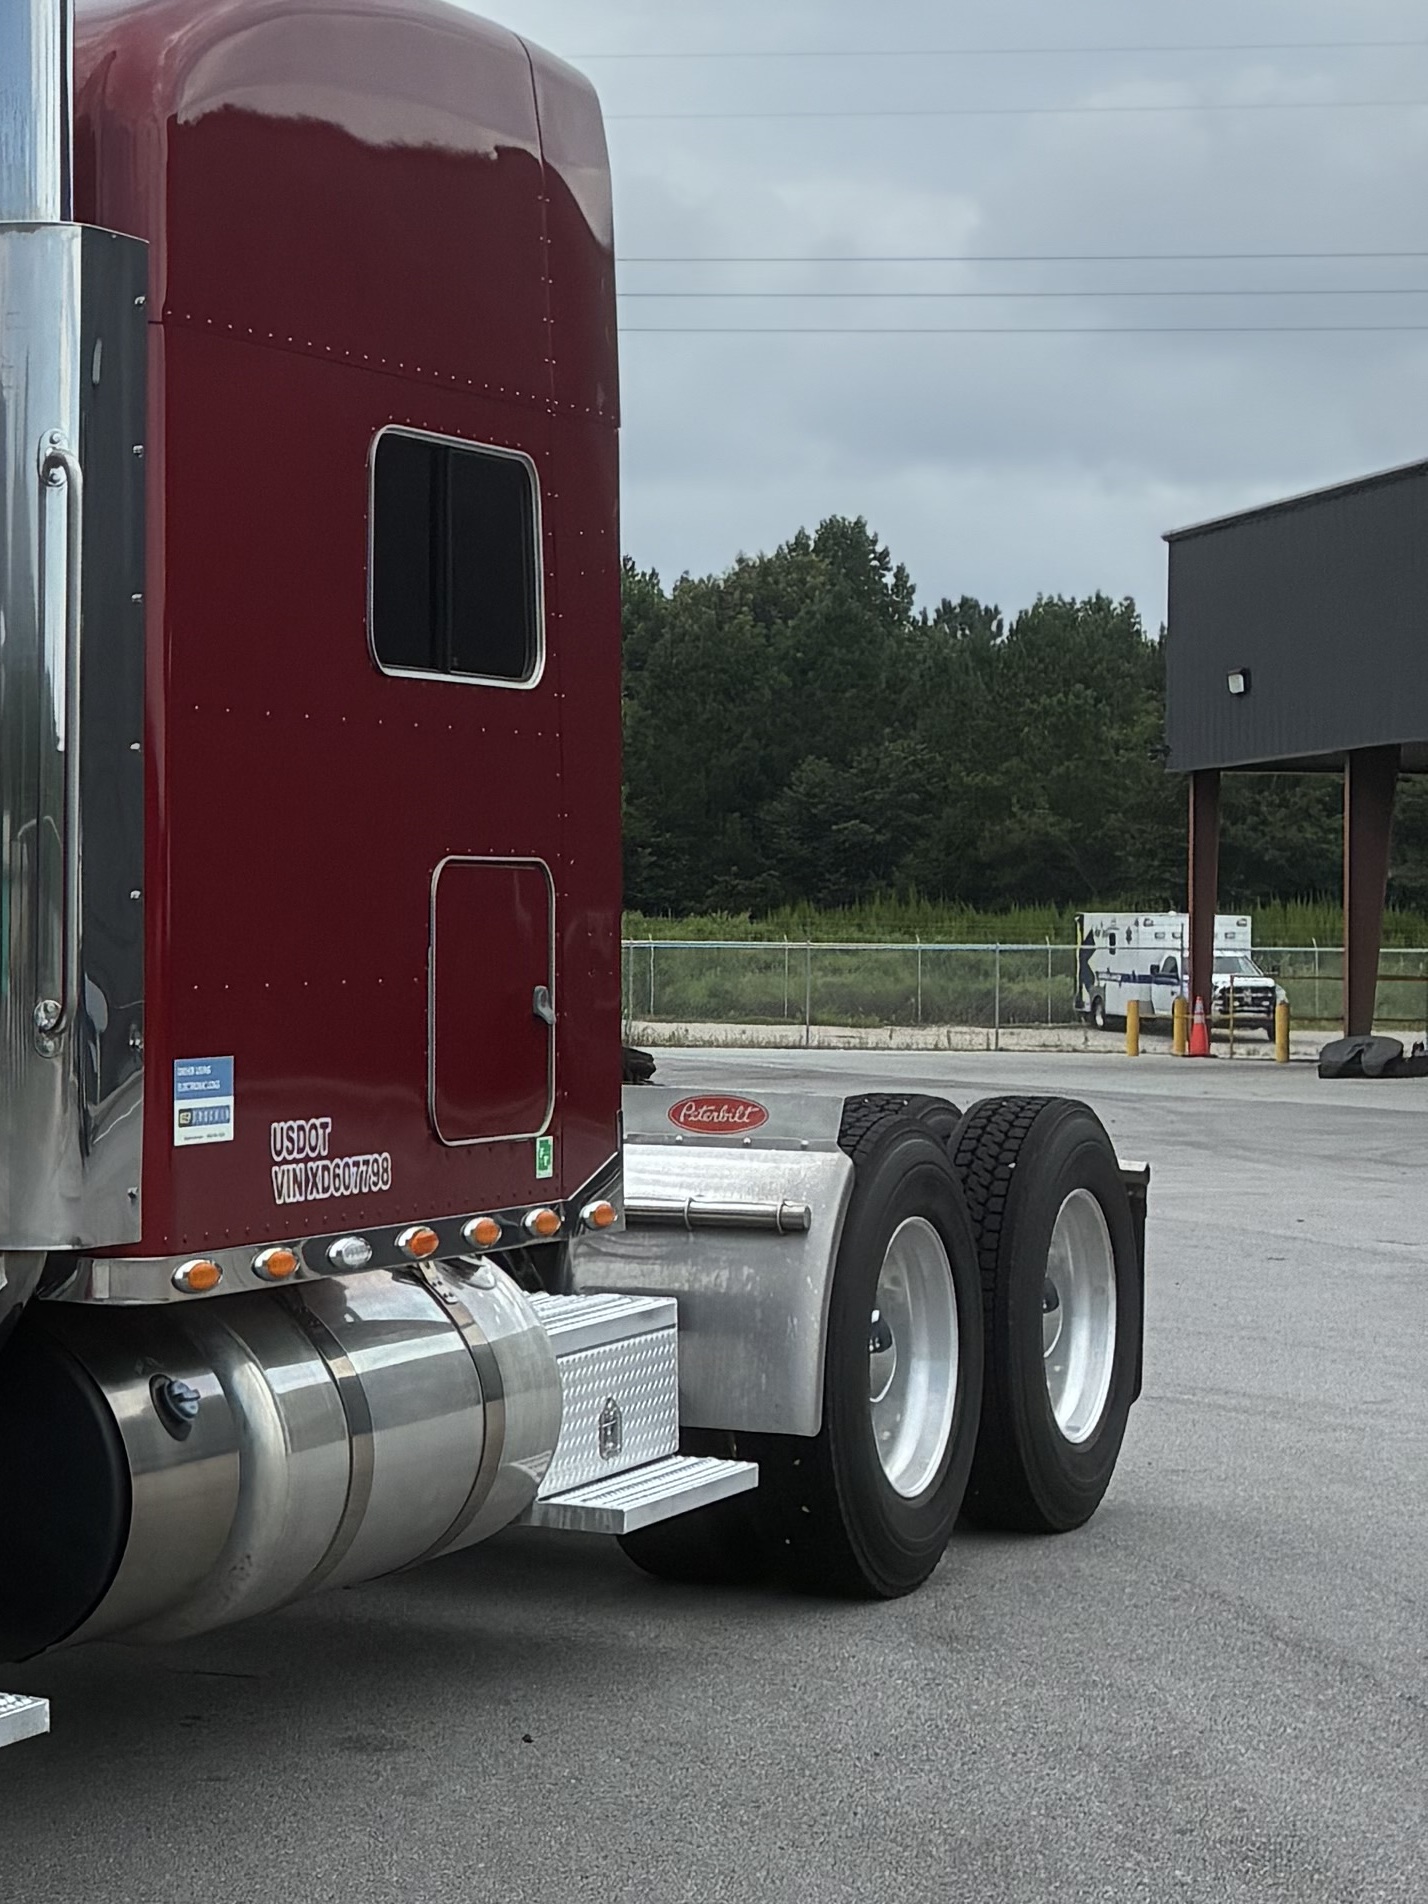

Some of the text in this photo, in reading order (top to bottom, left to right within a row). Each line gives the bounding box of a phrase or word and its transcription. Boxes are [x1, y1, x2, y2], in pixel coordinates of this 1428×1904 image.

[678, 1100, 760, 1124] Peterbilt
[271, 1117, 332, 1162] USDOT
[271, 1152, 392, 1205] VIN XD607798
